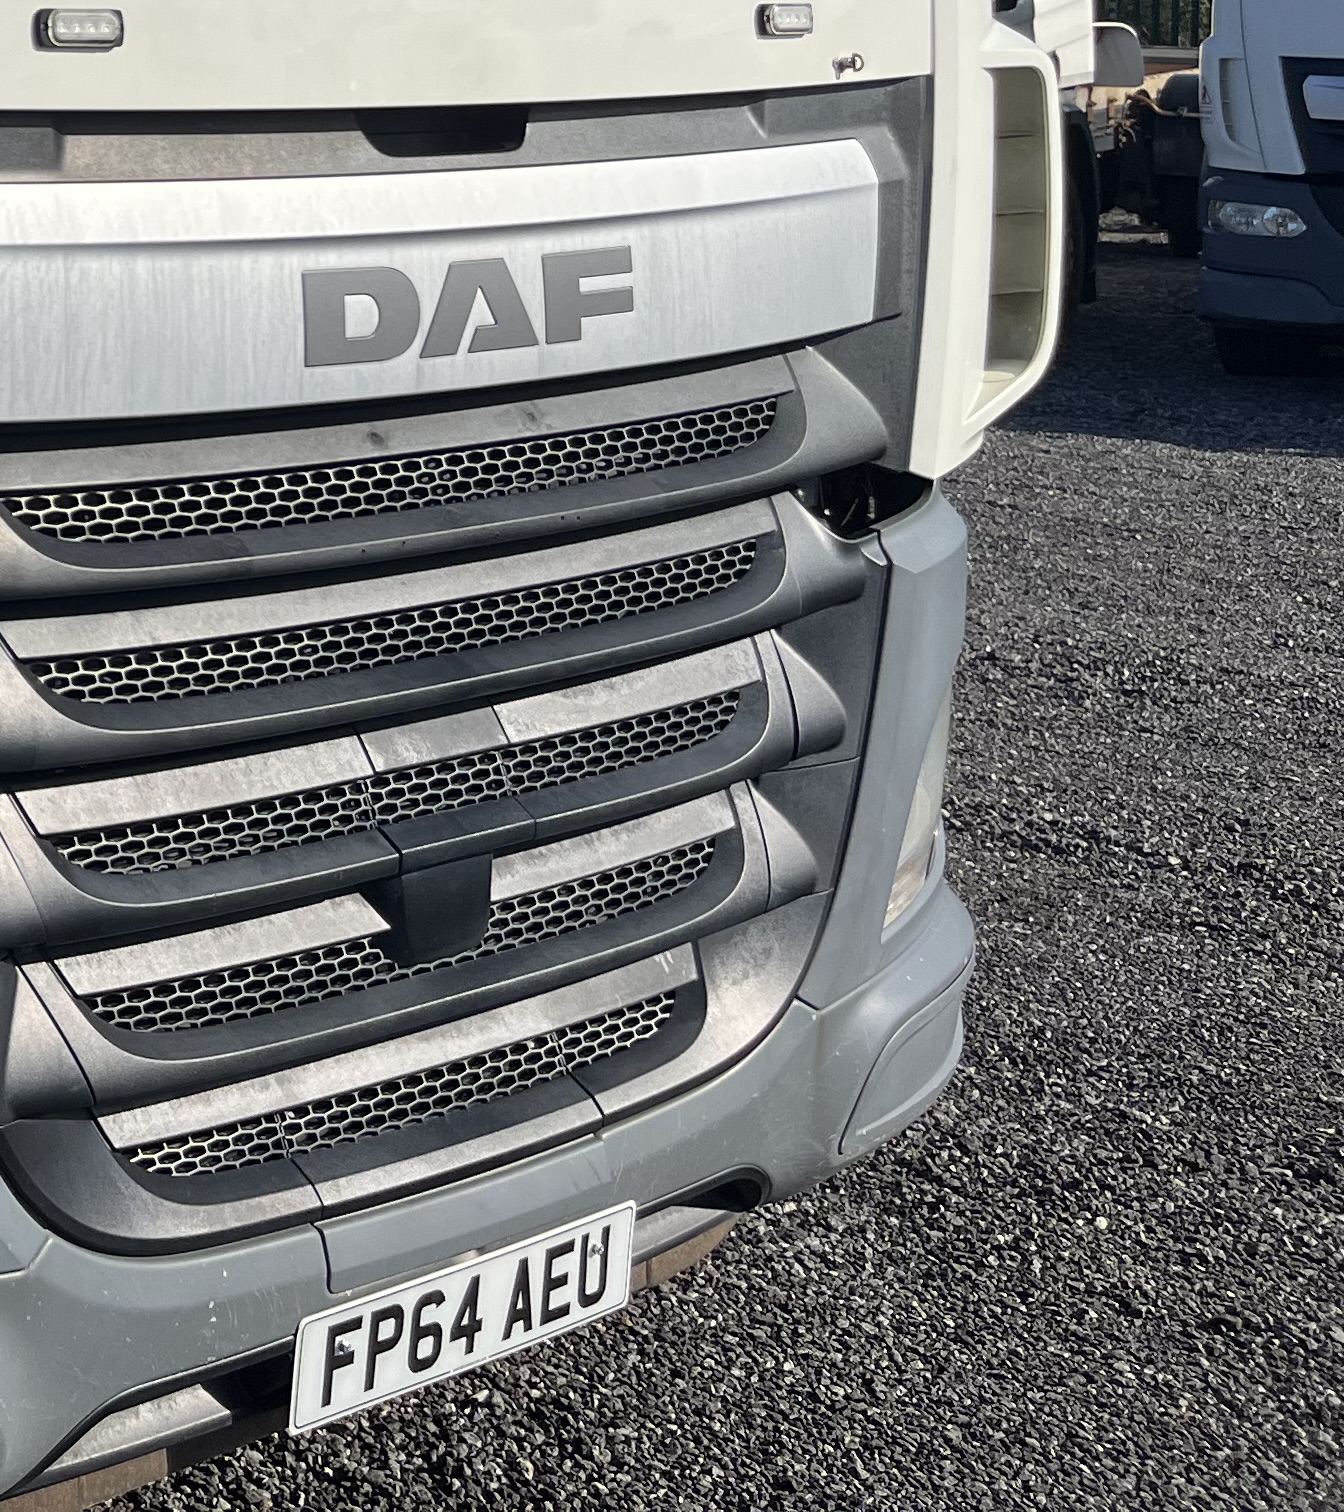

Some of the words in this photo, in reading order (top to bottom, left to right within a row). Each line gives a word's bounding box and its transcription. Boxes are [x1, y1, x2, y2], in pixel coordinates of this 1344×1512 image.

[301, 245, 634, 367] DAF
[320, 1274, 483, 1408] FP64
[502, 1224, 612, 1340] AEU
